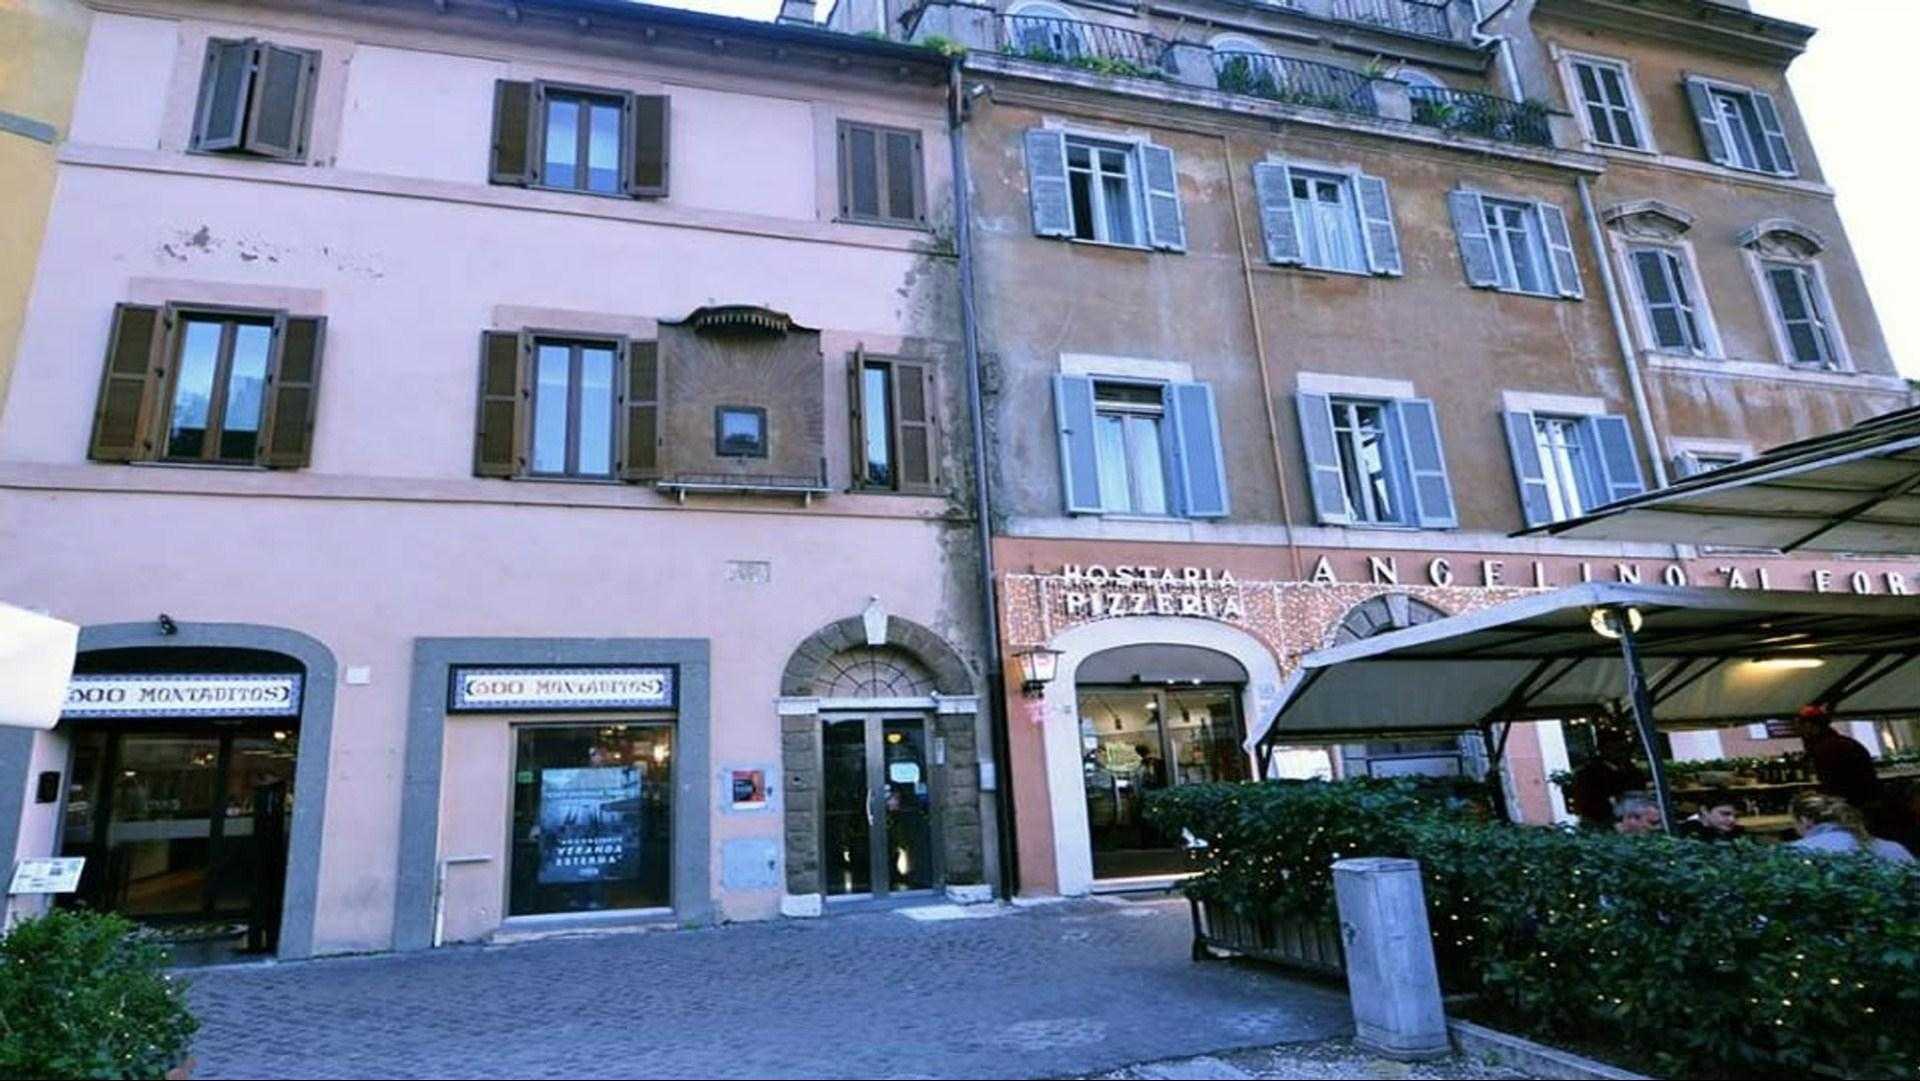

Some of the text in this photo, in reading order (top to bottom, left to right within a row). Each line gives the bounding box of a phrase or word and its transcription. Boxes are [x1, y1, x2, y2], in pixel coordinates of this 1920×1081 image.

[1063, 563, 1236, 588] HOSTARIA
[1313, 554, 1687, 590] ANGELINO
[1066, 591, 1241, 616] PIZZERIA
